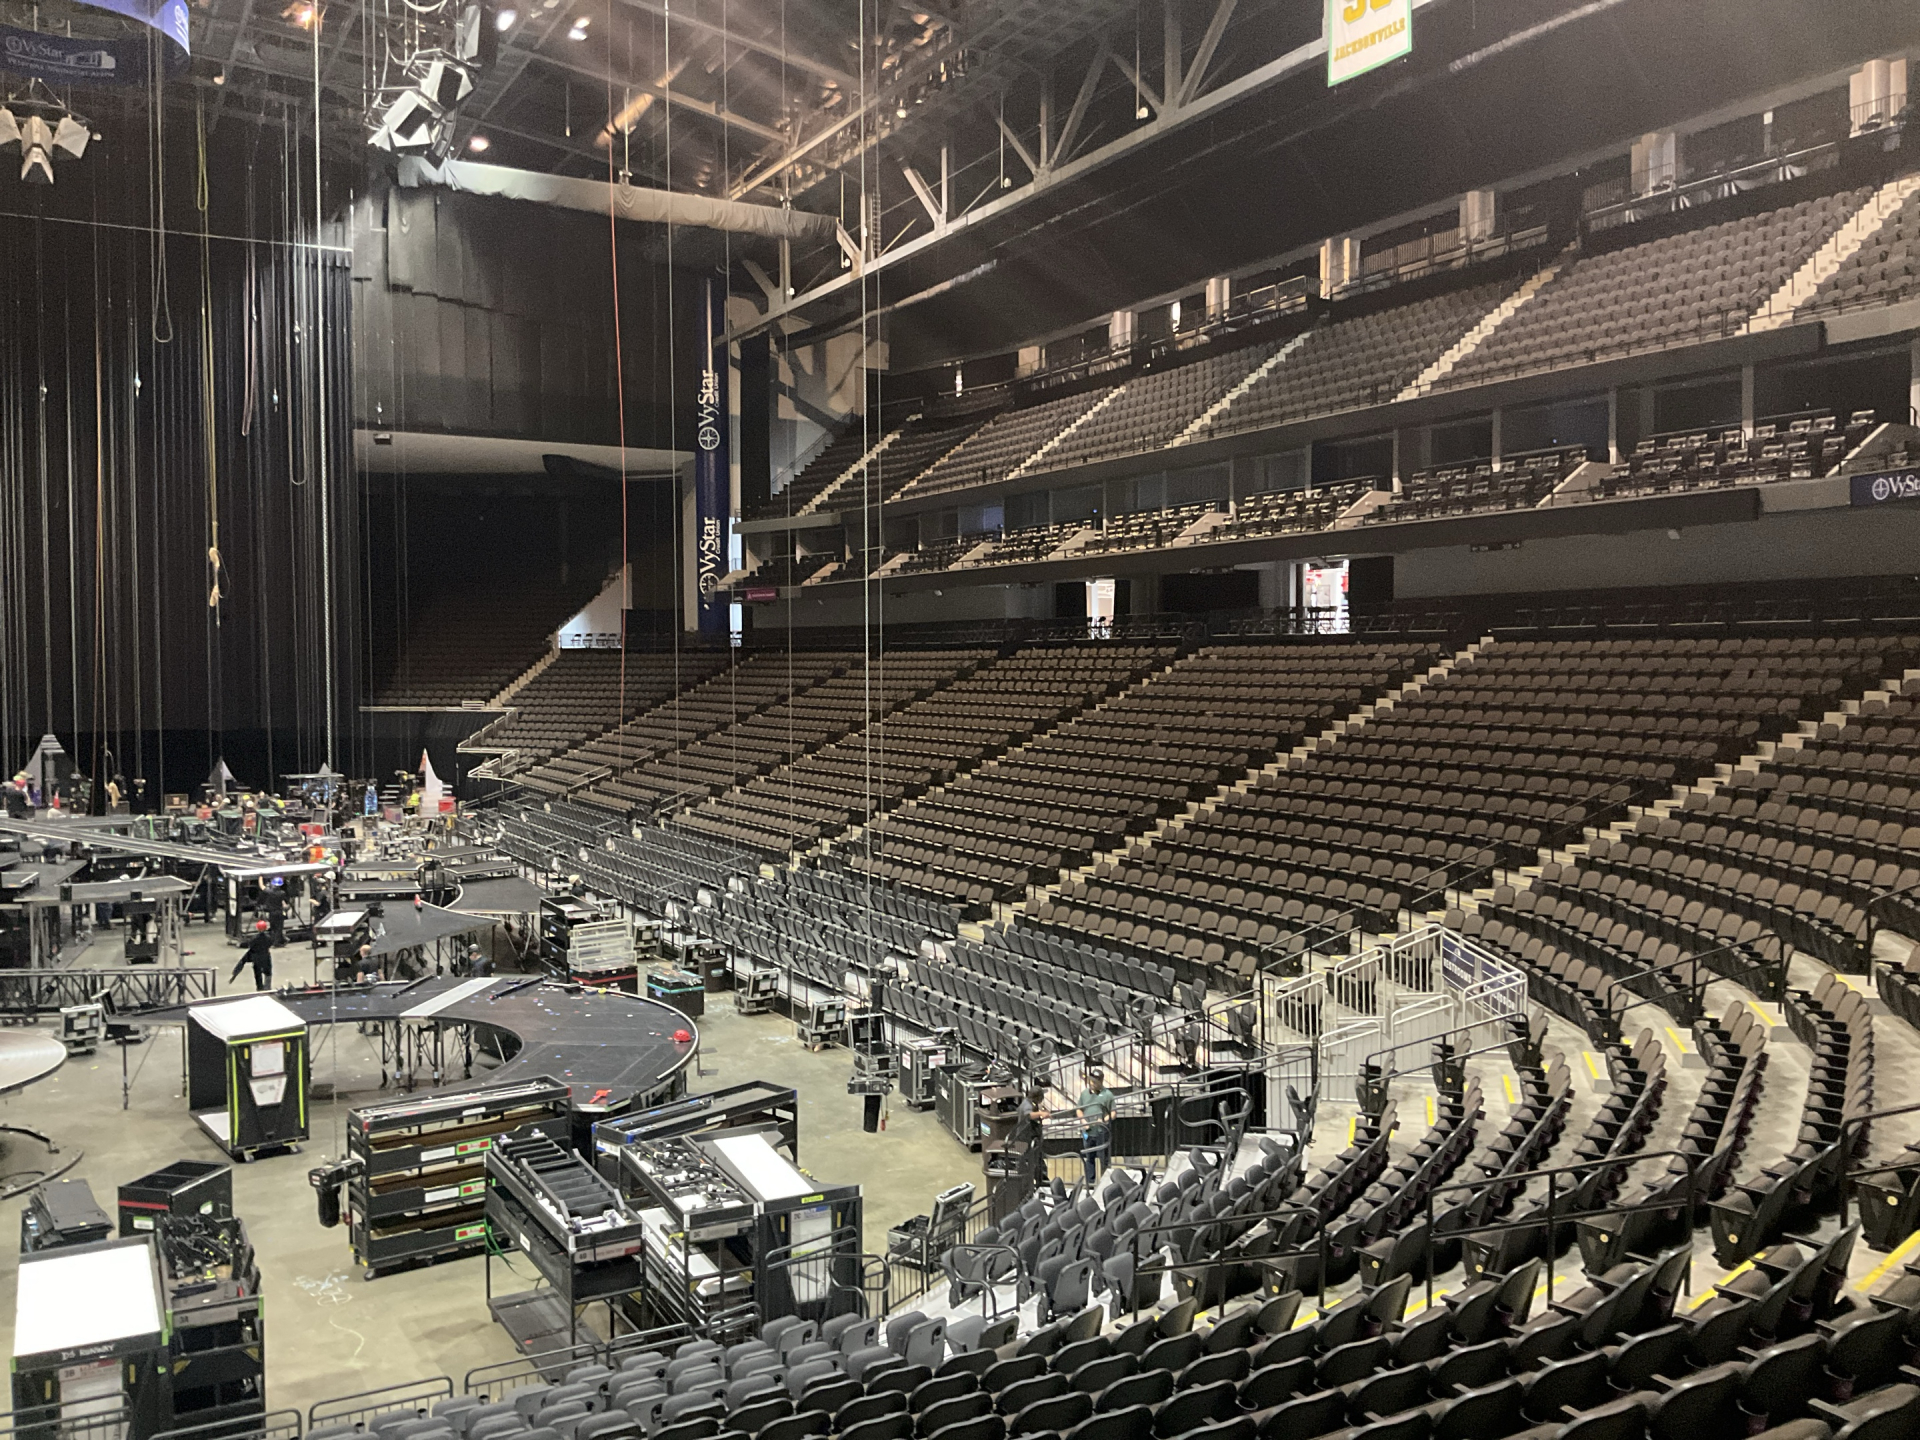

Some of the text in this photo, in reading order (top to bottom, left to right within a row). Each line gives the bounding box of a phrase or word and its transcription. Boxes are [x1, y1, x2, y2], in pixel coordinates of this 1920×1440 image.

[1333, 17, 1406, 62] JACKSONVILLE
[698, 370, 720, 428] VyStar
[699, 516, 720, 573] VyStar
[1443, 957, 1472, 984] RESTROOMS
